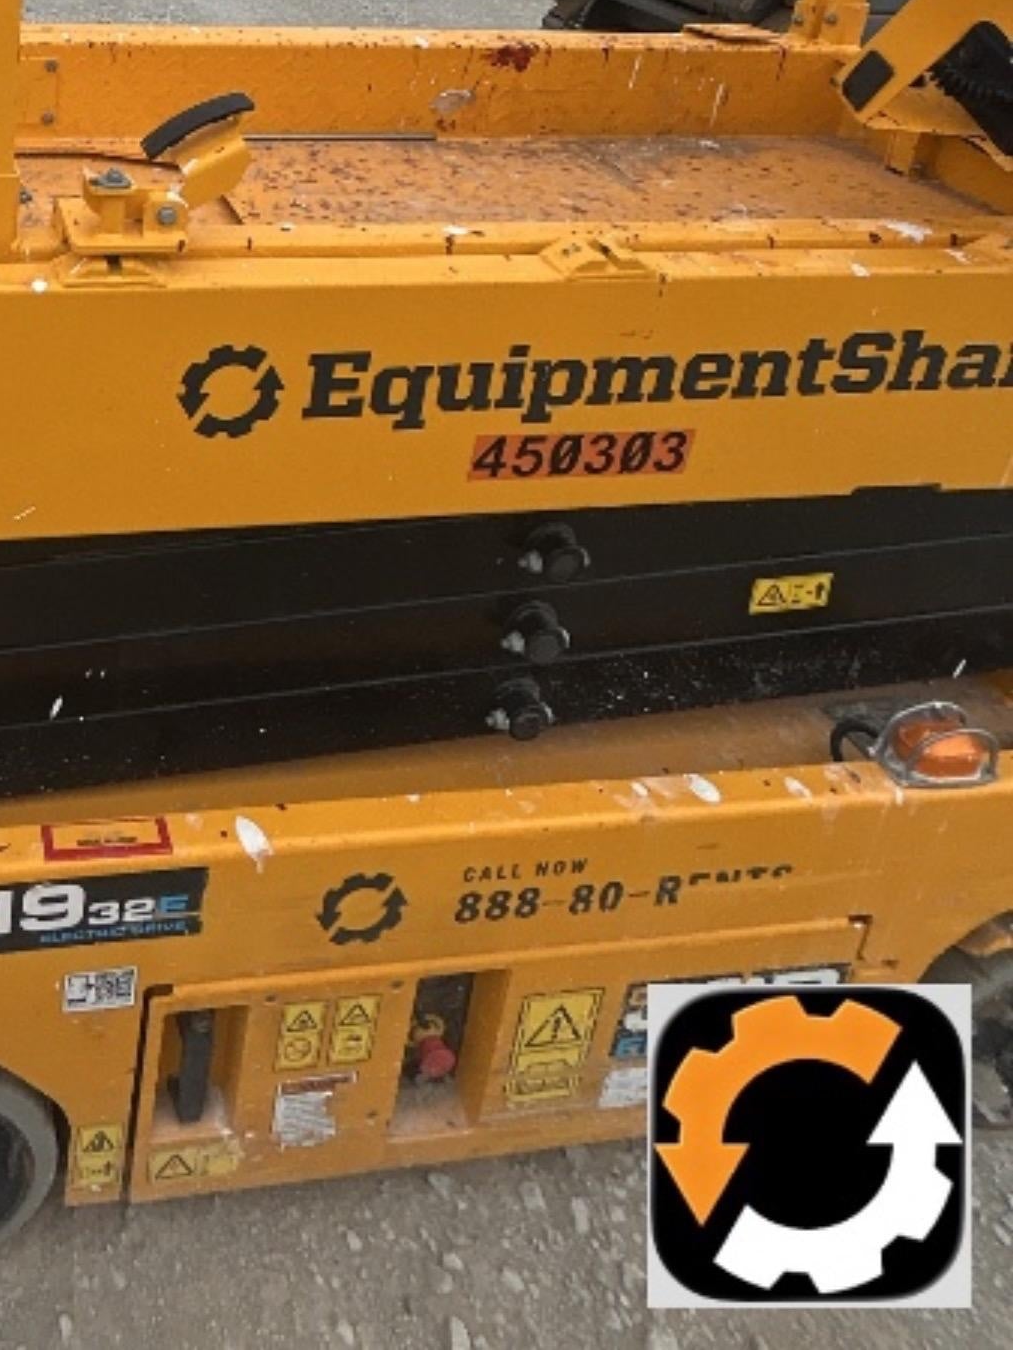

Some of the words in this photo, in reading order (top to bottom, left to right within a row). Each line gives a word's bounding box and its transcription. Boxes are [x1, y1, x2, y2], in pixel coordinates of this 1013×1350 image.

[472, 431, 688, 479] 450303
[463, 864, 521, 883] CALL
[535, 858, 588, 877] NOW
